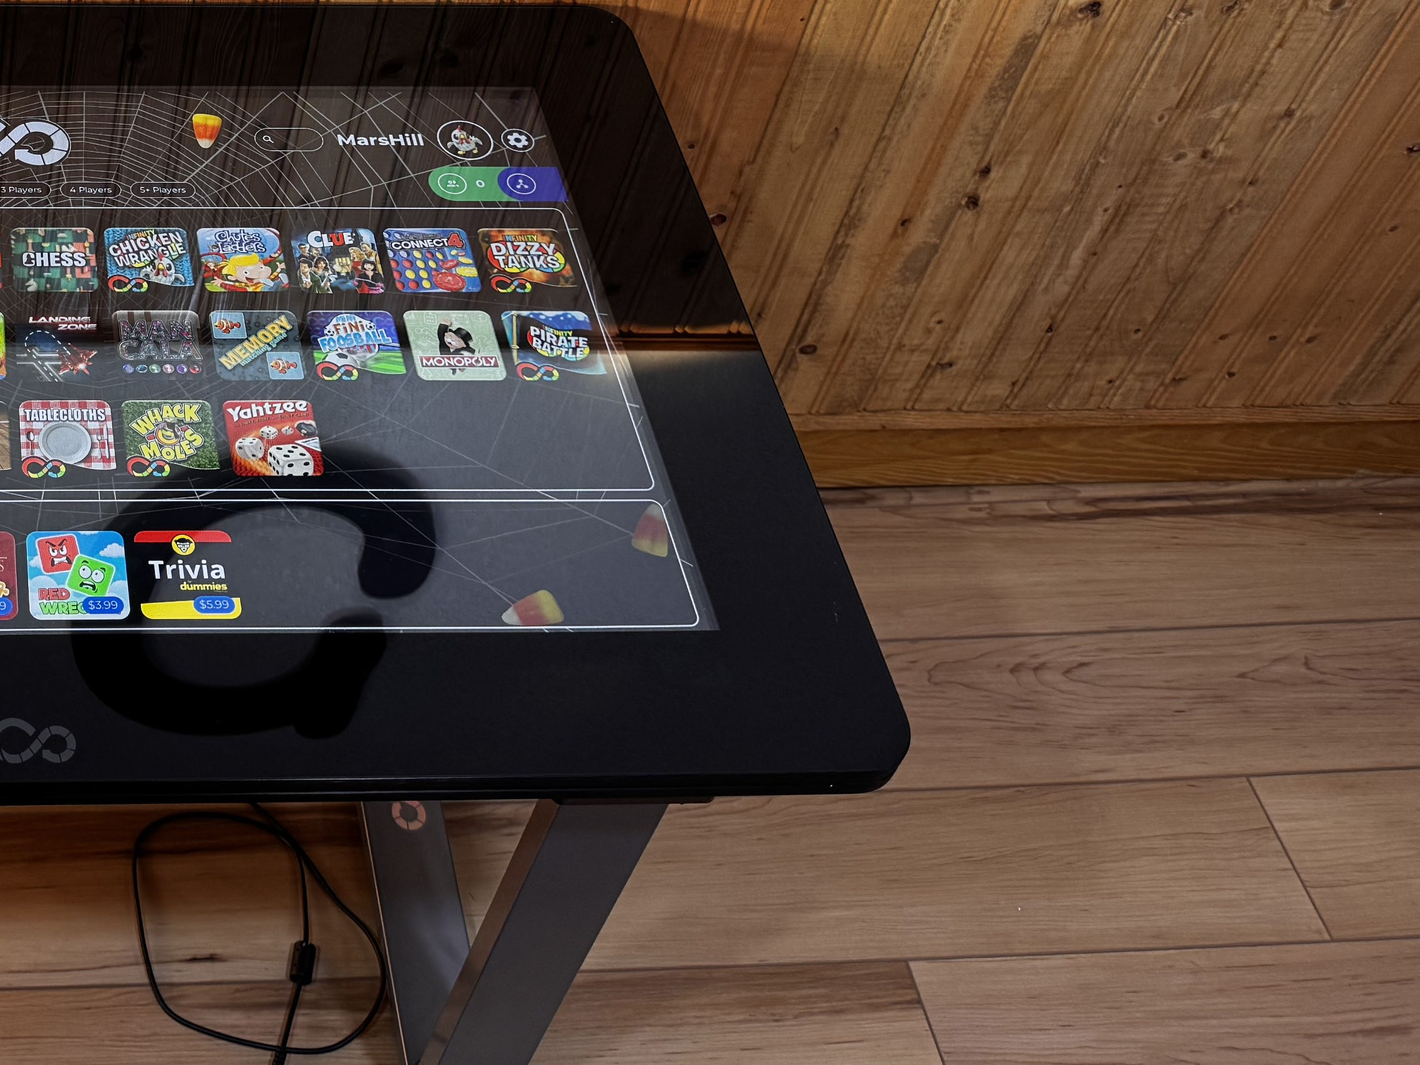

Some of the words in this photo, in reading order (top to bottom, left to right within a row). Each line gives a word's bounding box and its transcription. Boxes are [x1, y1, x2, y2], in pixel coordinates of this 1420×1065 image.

[336, 133, 425, 147] MarsHill
[8, 185, 43, 196] Players
[78, 185, 113, 196] Players
[139, 186, 151, 194] 5+
[152, 185, 187, 196] Players
[108, 231, 183, 257] CHICKEN
[307, 231, 355, 248] CLUE
[391, 238, 449, 251] CONNECT
[447, 232, 465, 249] 4
[113, 243, 187, 269] WRANGLE
[490, 242, 557, 257] DIZZY
[22, 252, 88, 268] CHESS
[494, 254, 561, 270] TANKS
[28, 316, 92, 324] LANDING
[57, 323, 98, 331] ZONE
[218, 314, 294, 371] MEMORY
[318, 328, 392, 353] FOOSBALL
[529, 325, 589, 349] PIRATE
[531, 338, 586, 359] BATTLE
[421, 356, 498, 368] MONOPOLY
[23, 408, 106, 422] TABLECLOTHS
[131, 402, 201, 436] WHACK
[226, 399, 309, 423] Yahtzee
[138, 429, 205, 461] MOLES
[147, 559, 226, 580] Trivia
[38, 588, 71, 601] RED
[179, 581, 228, 592] dummies
[87, 599, 119, 611] $3.99
[198, 599, 230, 611] $5.99
